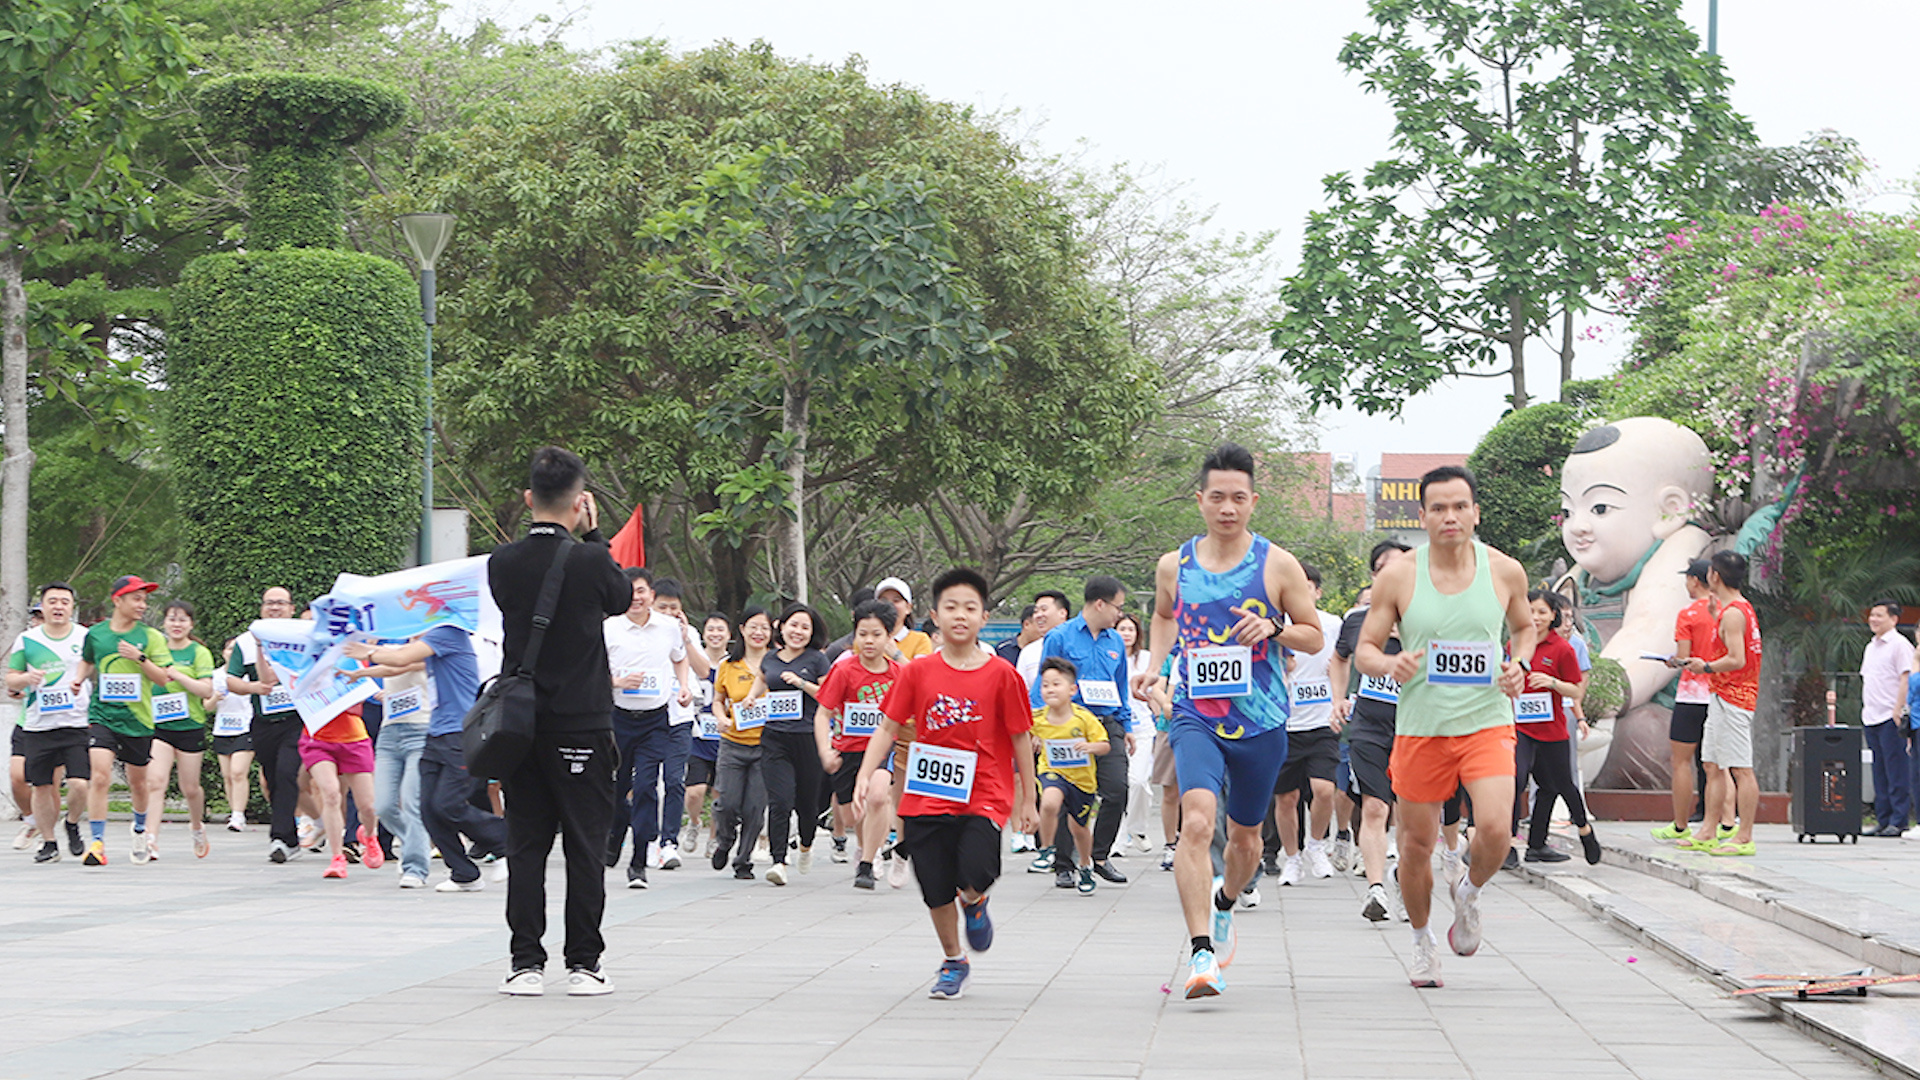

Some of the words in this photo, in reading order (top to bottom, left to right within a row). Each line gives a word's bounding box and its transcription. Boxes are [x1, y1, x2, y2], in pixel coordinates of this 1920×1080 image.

[1436, 653, 1486, 674] 9936
[1197, 660, 1242, 683] 9920
[106, 681, 135, 694] 9980
[1086, 687, 1113, 699] 9899
[1297, 684, 1327, 699] 9946
[42, 692, 69, 706] 9961
[771, 699, 797, 713] 9986
[156, 700, 182, 714] 9983
[1519, 700, 1547, 713] 9951
[851, 712, 884, 726] 9900
[917, 758, 965, 785] 9995
